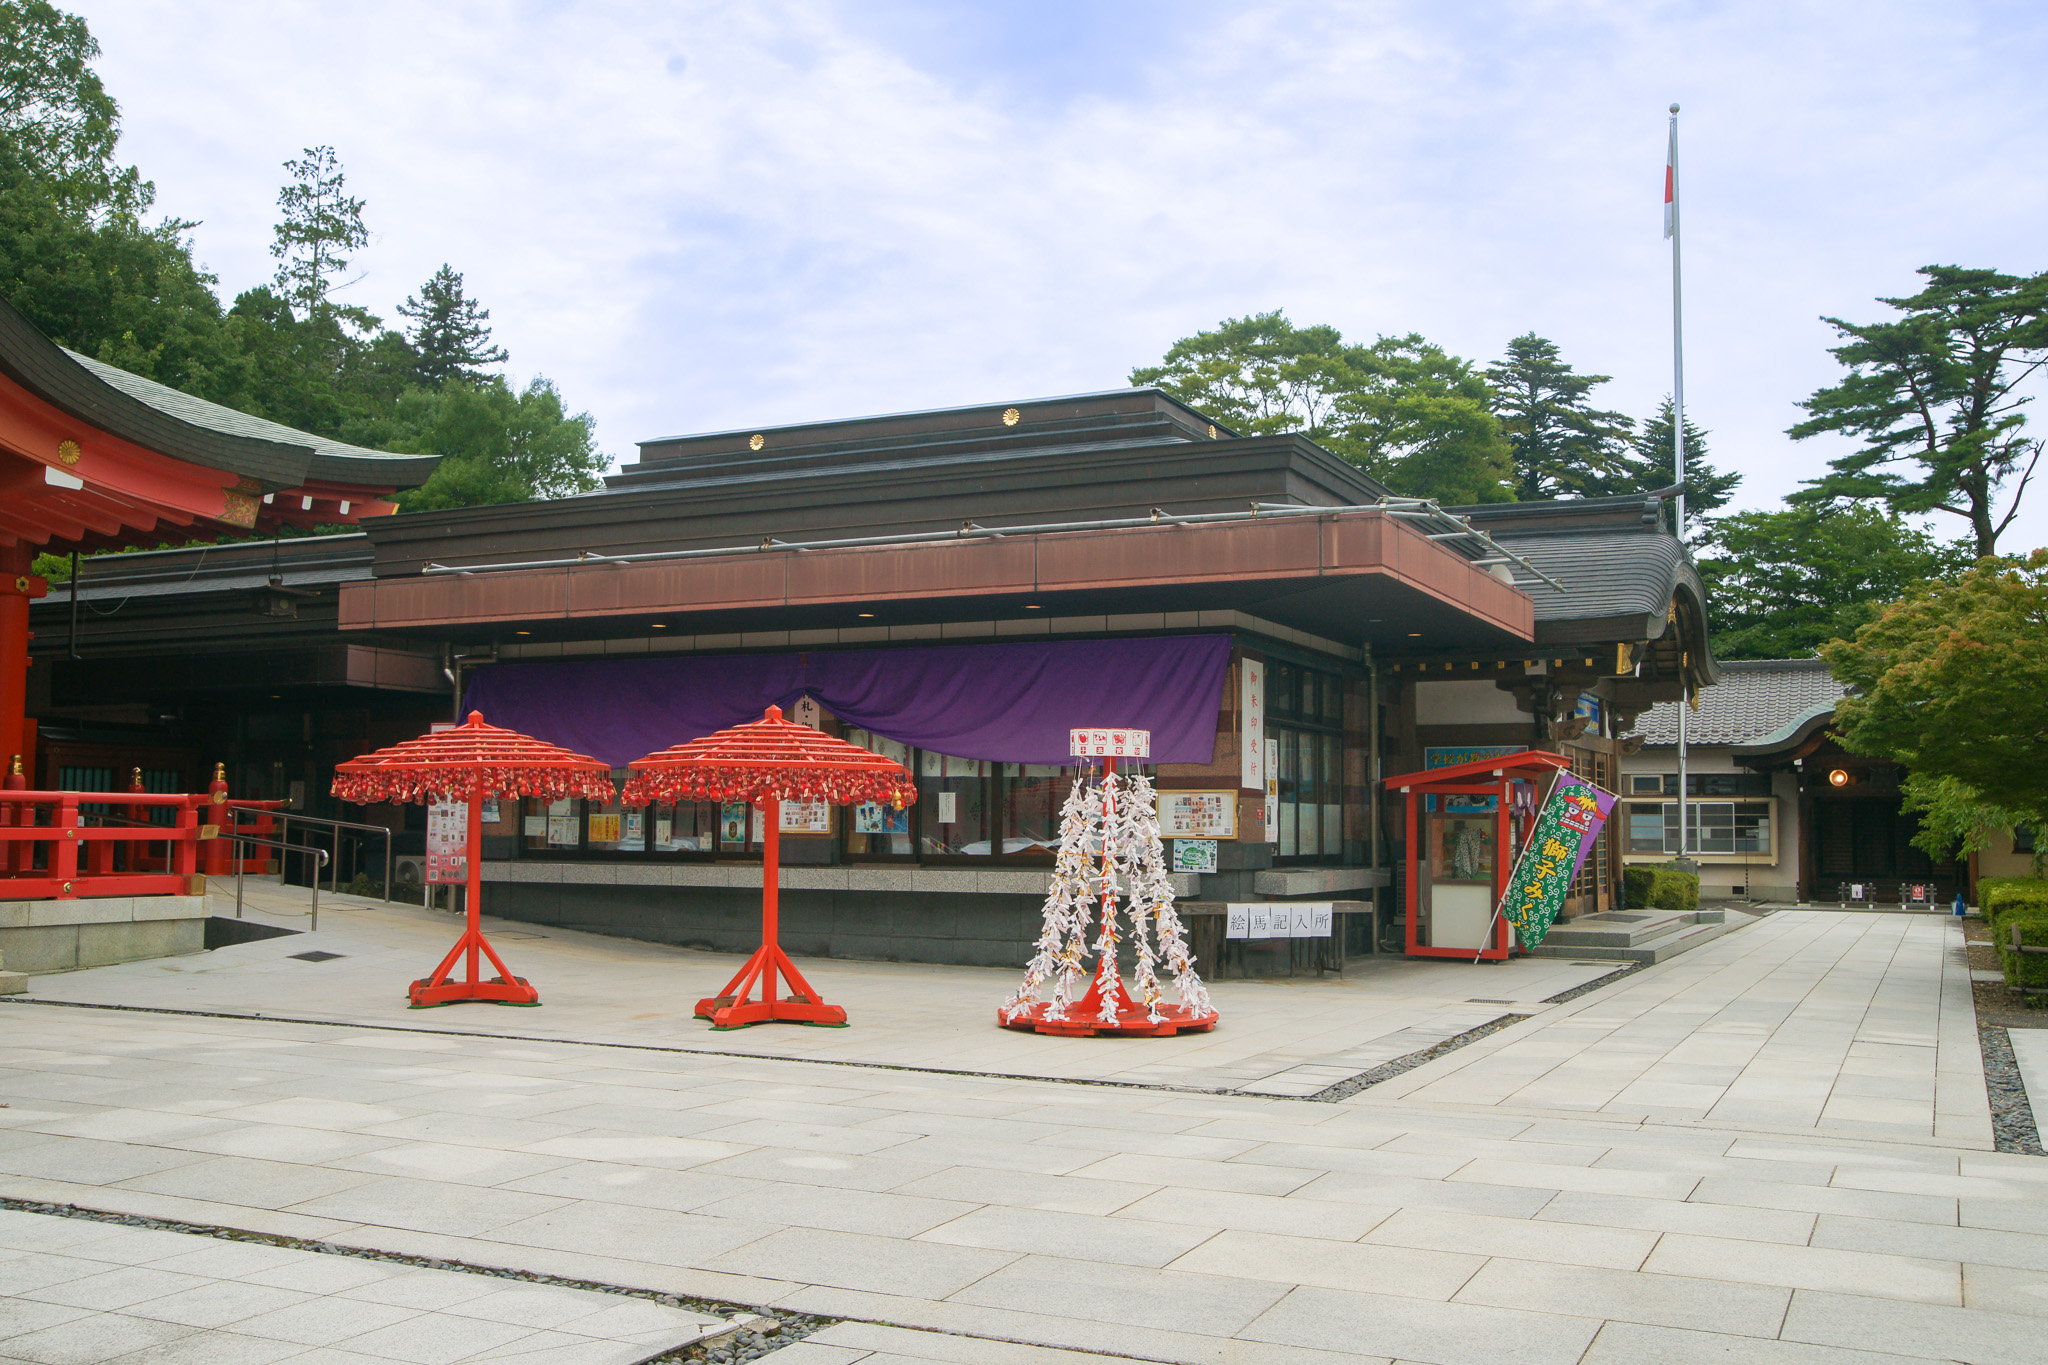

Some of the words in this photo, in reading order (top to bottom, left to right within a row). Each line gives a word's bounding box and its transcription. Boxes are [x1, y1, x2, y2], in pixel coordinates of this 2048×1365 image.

[1249, 670, 1259, 777] 御朱印受付
[1230, 913, 1329, 931] 絵馬記入所
